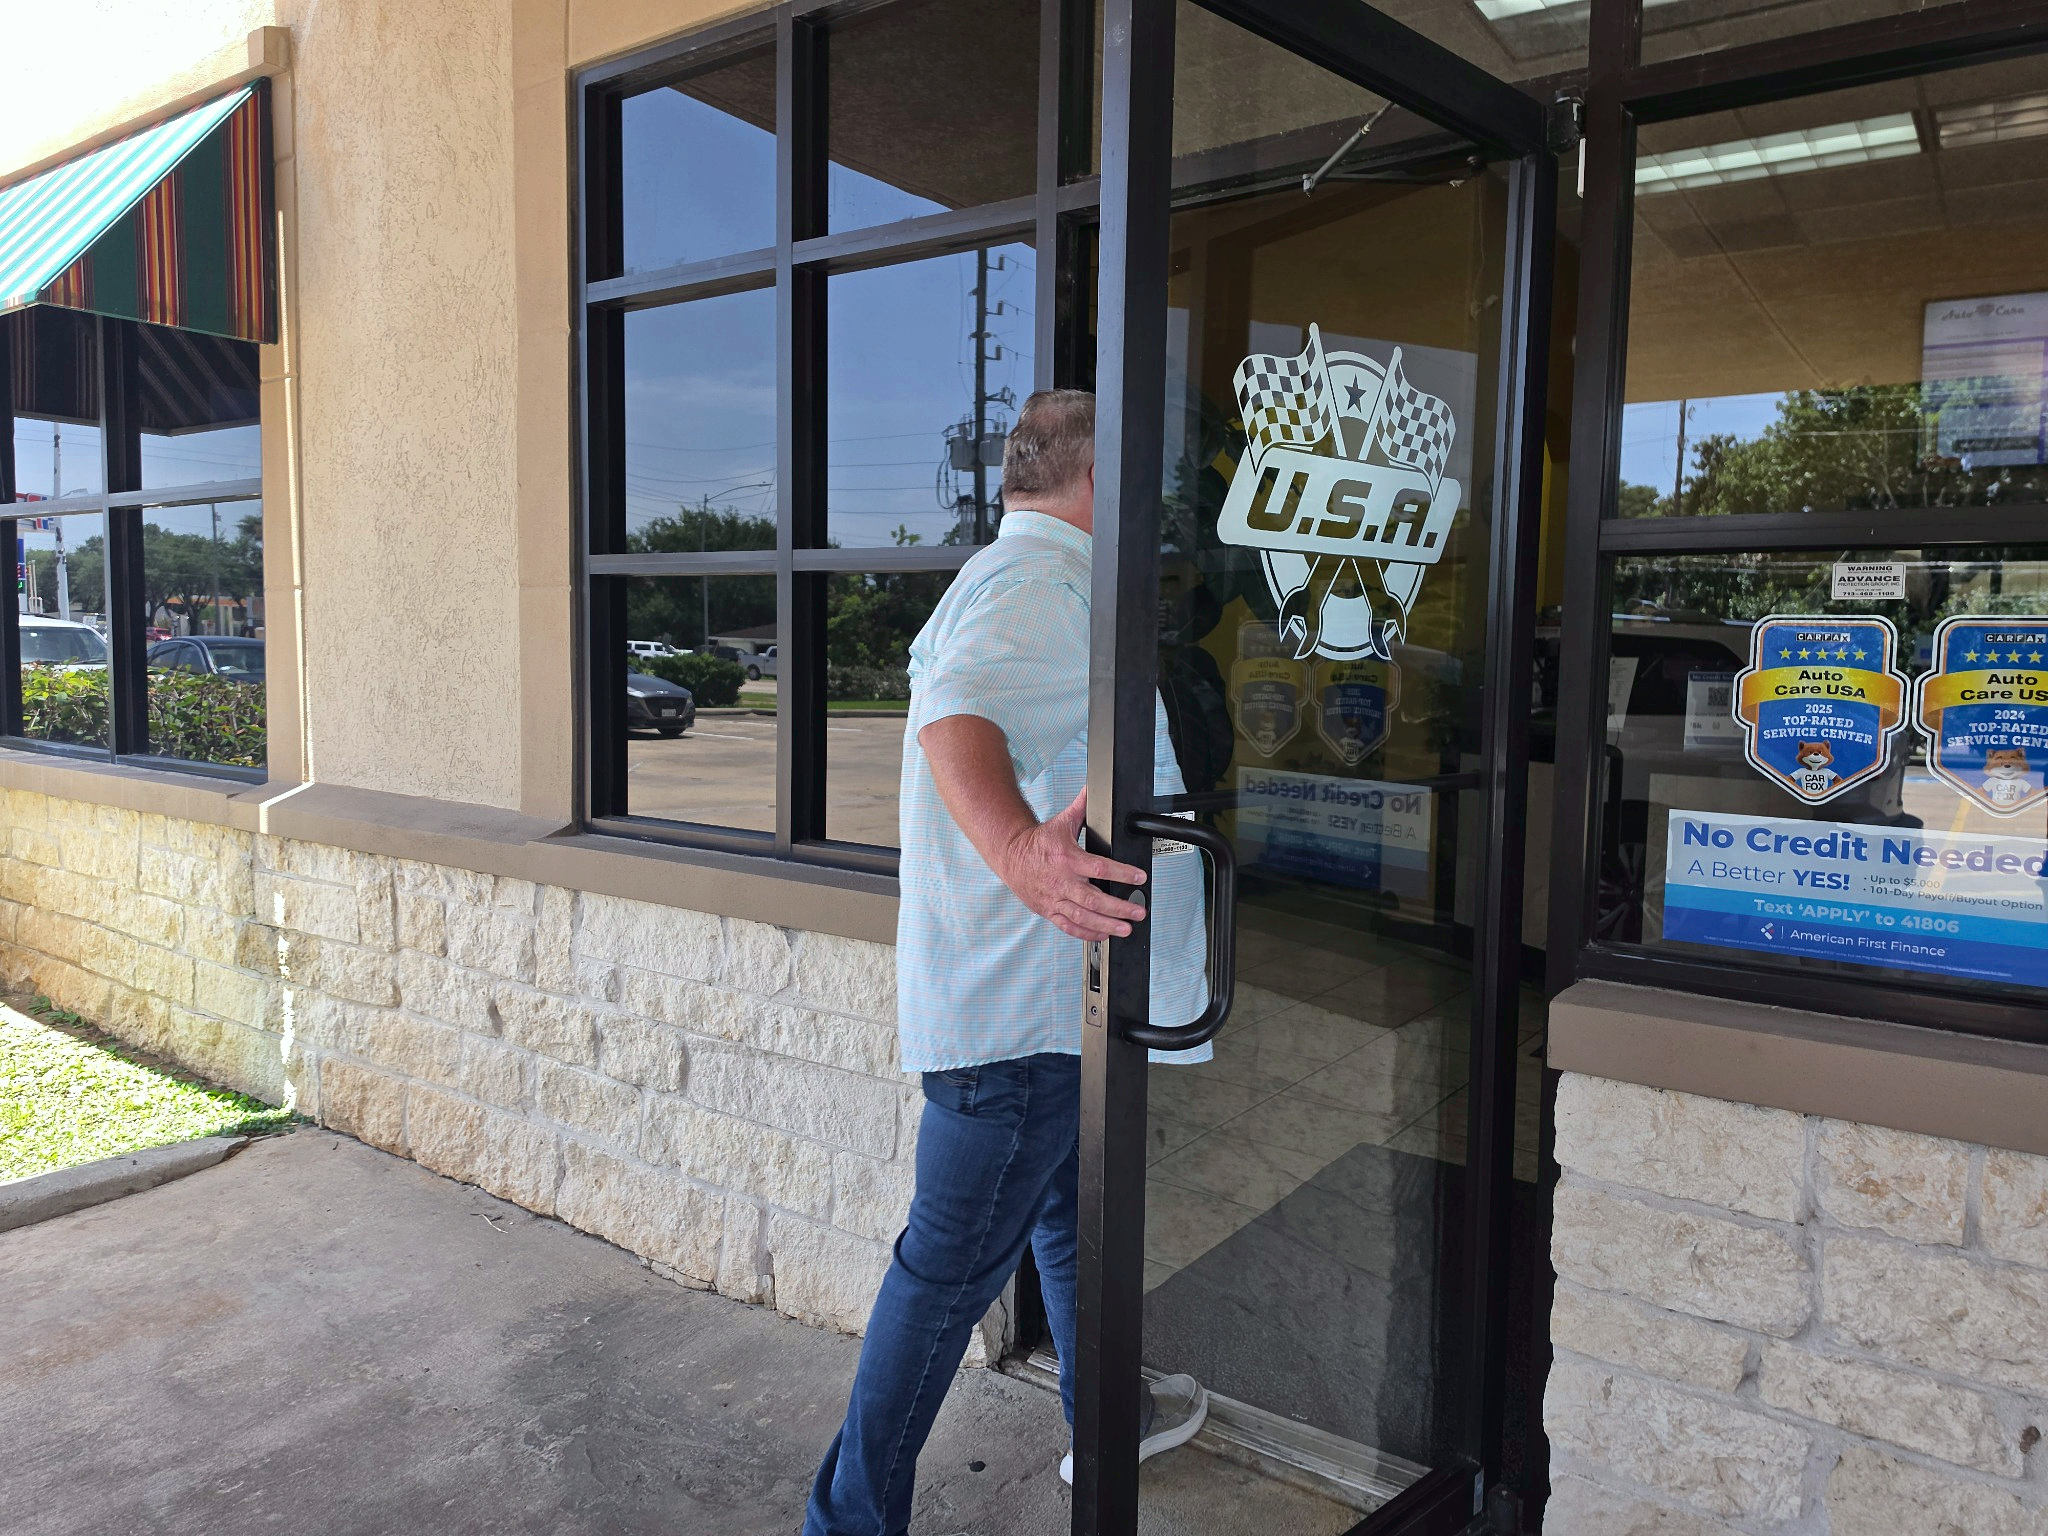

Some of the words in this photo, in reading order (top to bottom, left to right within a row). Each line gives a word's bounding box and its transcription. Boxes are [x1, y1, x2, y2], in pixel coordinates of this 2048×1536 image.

[1247, 466, 1438, 549] U.S.A.
[1796, 632, 1850, 642] CARFAX
[1985, 633, 2046, 644] CARFAX
[1798, 669, 1844, 682] Auto
[1987, 673, 2038, 686] Auto
[1774, 684, 1822, 696] Care
[1826, 684, 1866, 699] USA
[1960, 689, 2014, 701] Care
[2019, 688, 2048, 702] US
[1805, 703, 1833, 714] 2025
[1994, 709, 2026, 721] 2024
[1782, 716, 1854, 728] TOP-RATED
[1968, 722, 2048, 736] TOP-RATED
[1763, 728, 1818, 740] SERVICE
[1820, 728, 1873, 745] CENTER
[1947, 734, 2008, 748] SERVICE
[2011, 735, 2048, 749] CENT
[1804, 774, 1825, 783] CAR
[1805, 782, 1825, 791] FOX
[1995, 782, 2017, 793] CAR
[1996, 792, 2015, 801] FOX
[1683, 821, 1734, 849] No
[1746, 827, 1868, 862] Credit
[1882, 837, 2048, 878] Needed
[1687, 859, 1705, 876] A
[1712, 861, 1786, 884] Better
[1792, 868, 1850, 891] YES!
[1870, 874, 1886, 885] Up
[1889, 876, 1900, 886] to
[1903, 877, 1941, 889] $5,000
[1870, 885, 1914, 899] 101-Day
[1918, 891, 1998, 906] Payoff/Buyout
[2001, 899, 2043, 911] Option
[1754, 898, 1793, 915] Text
[1875, 912, 1896, 927] to
[1900, 915, 1960, 933] 41806
[1790, 929, 1854, 947] American
[1857, 937, 1887, 950] First
[1890, 941, 1946, 957] Finance
